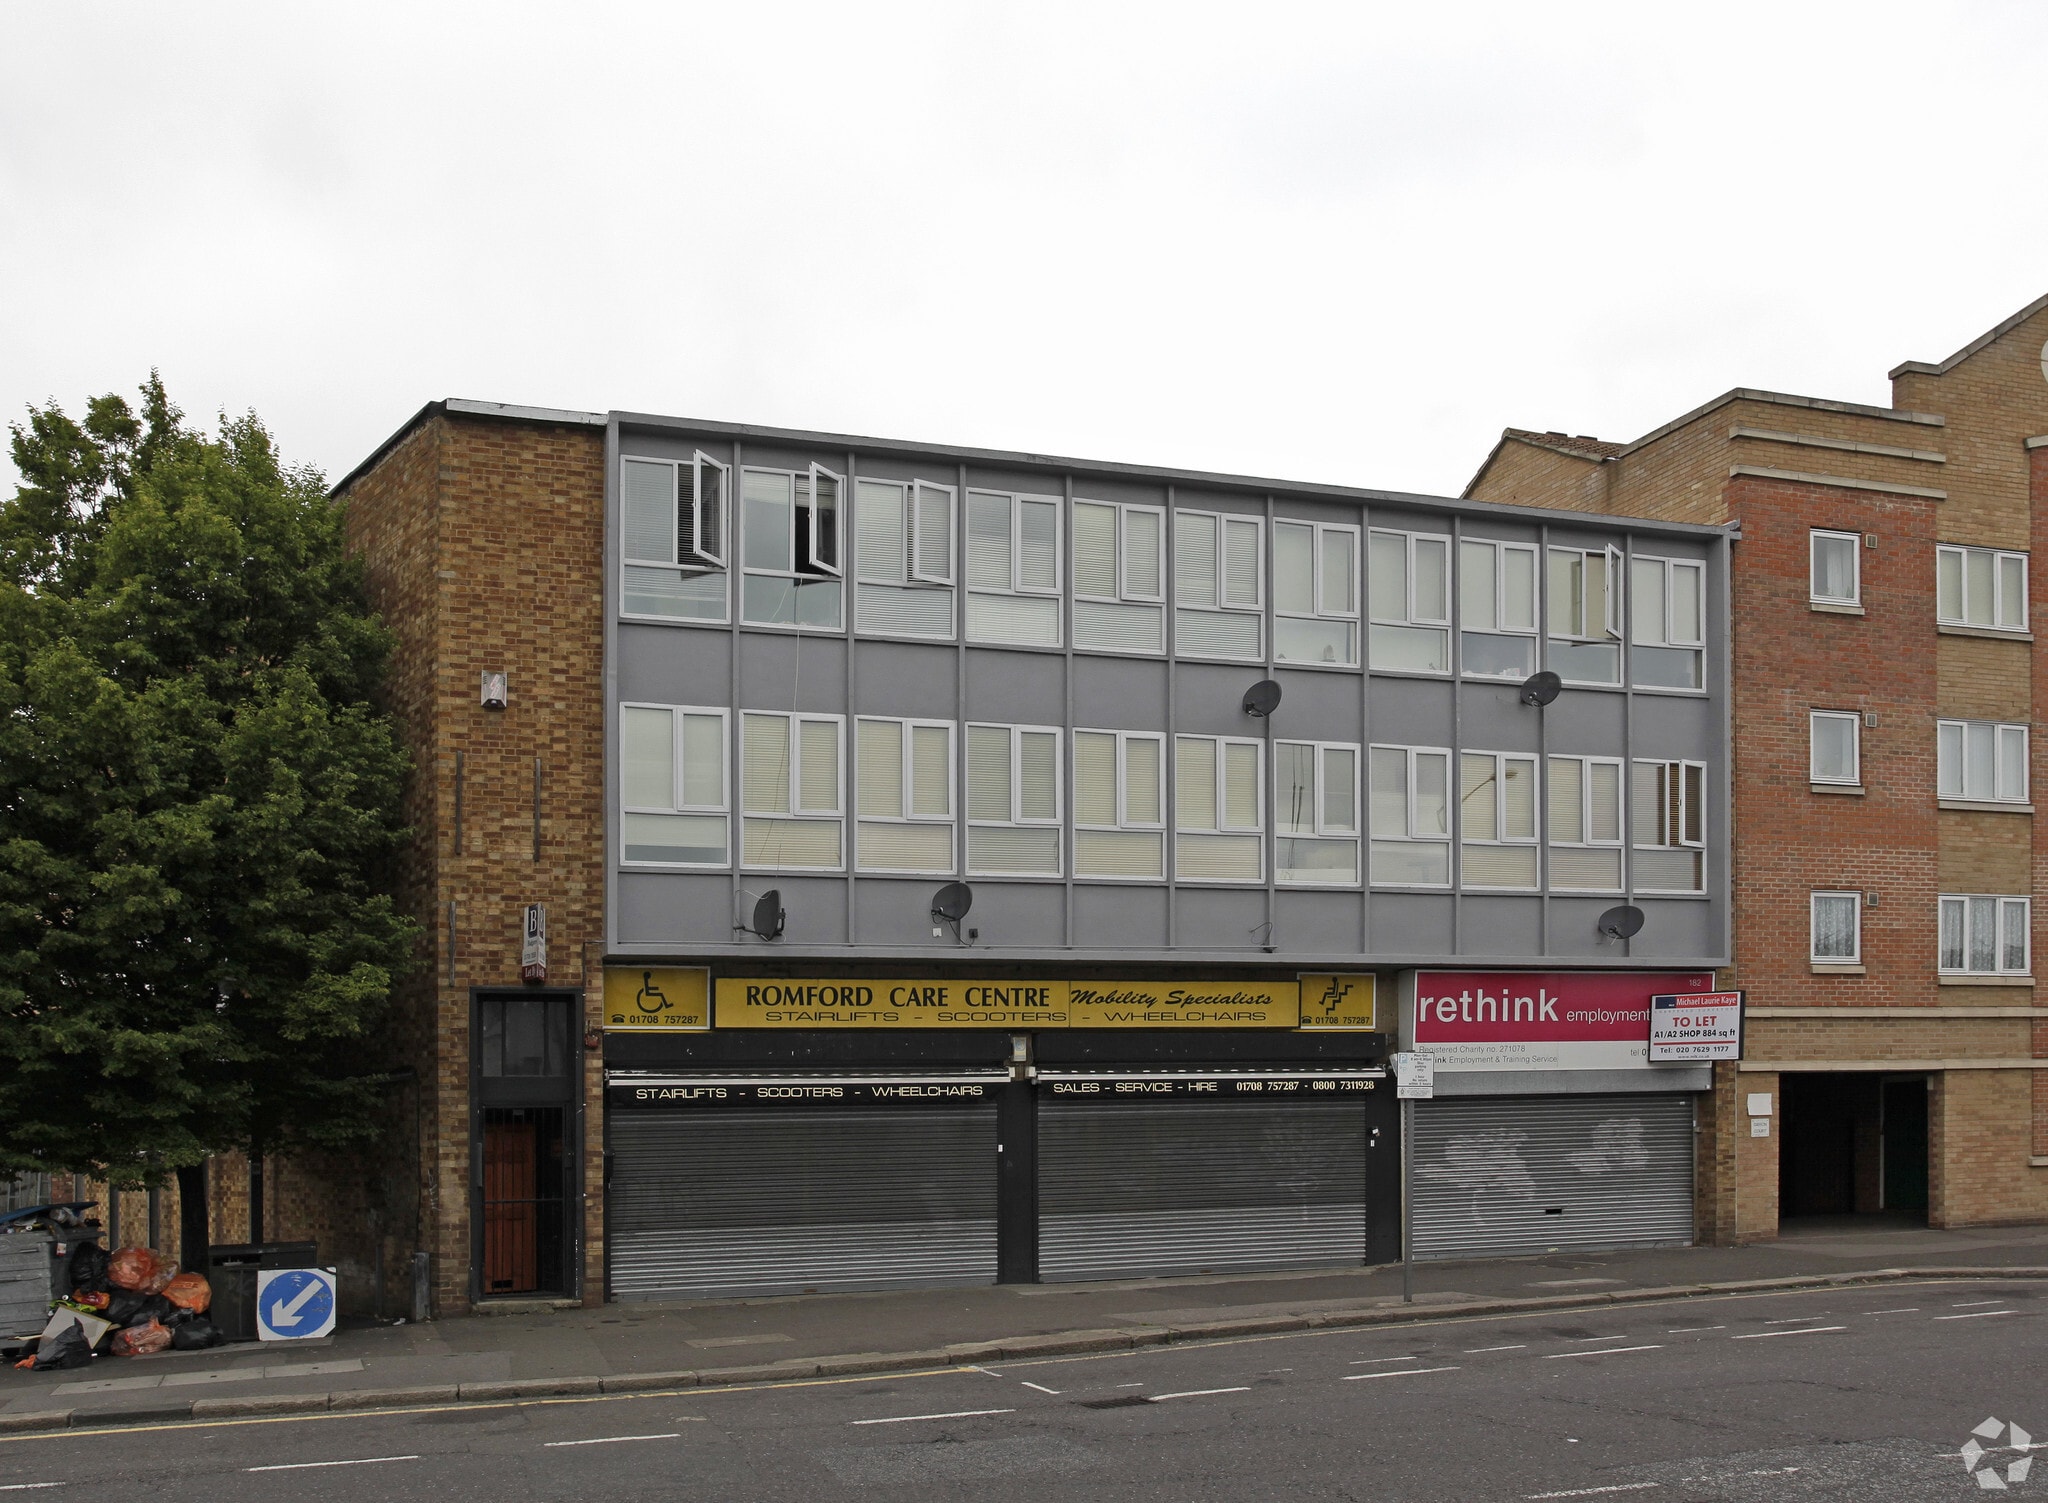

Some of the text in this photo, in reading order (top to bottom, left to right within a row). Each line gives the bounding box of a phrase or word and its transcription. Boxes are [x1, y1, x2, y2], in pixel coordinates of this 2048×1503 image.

[1689, 978, 1702, 986] 182
[746, 985, 1050, 1007] ROMFORD CARE CENTRE
[1070, 989, 1273, 1010] Mobility Specialists
[1676, 997, 1700, 1006] Michael
[1701, 996, 1720, 1005] Laurie
[1721, 995, 1737, 1006] Kaye
[1420, 988, 1651, 1024] rethink employment
[629, 1014, 699, 1025] 01708 757287
[765, 1011, 899, 1022] STAIRLIFTS
[937, 1011, 1067, 1022] SCOOTERS
[1104, 1011, 1266, 1022] WHEELCHAIRS
[1315, 1016, 1370, 1025] 01708 757287
[1673, 1016, 1717, 1027] TO LET
[1654, 1028, 1736, 1038] A1/A2 SHOP 884 sq ft
[1460, 1046, 1485, 1055] Charity
[1499, 1045, 1526, 1053] 271078
[1449, 1055, 1493, 1065] Employment
[1502, 1055, 1530, 1065] Training
[1532, 1055, 1558, 1063] Service
[1053, 1081, 1100, 1094] SALES
[1115, 1081, 1173, 1093] SERVICE
[1187, 1081, 1218, 1093] HIRE
[1236, 1081, 1263, 1092] 01708
[1267, 1080, 1299, 1091] 757287
[1312, 1080, 1336, 1091] 0800
[1340, 1080, 1375, 1091] 7311928
[636, 1087, 728, 1100] STAIRLIFTS
[757, 1086, 844, 1099] SCOOTERS
[871, 1085, 984, 1098] WHEELCHAIRS
